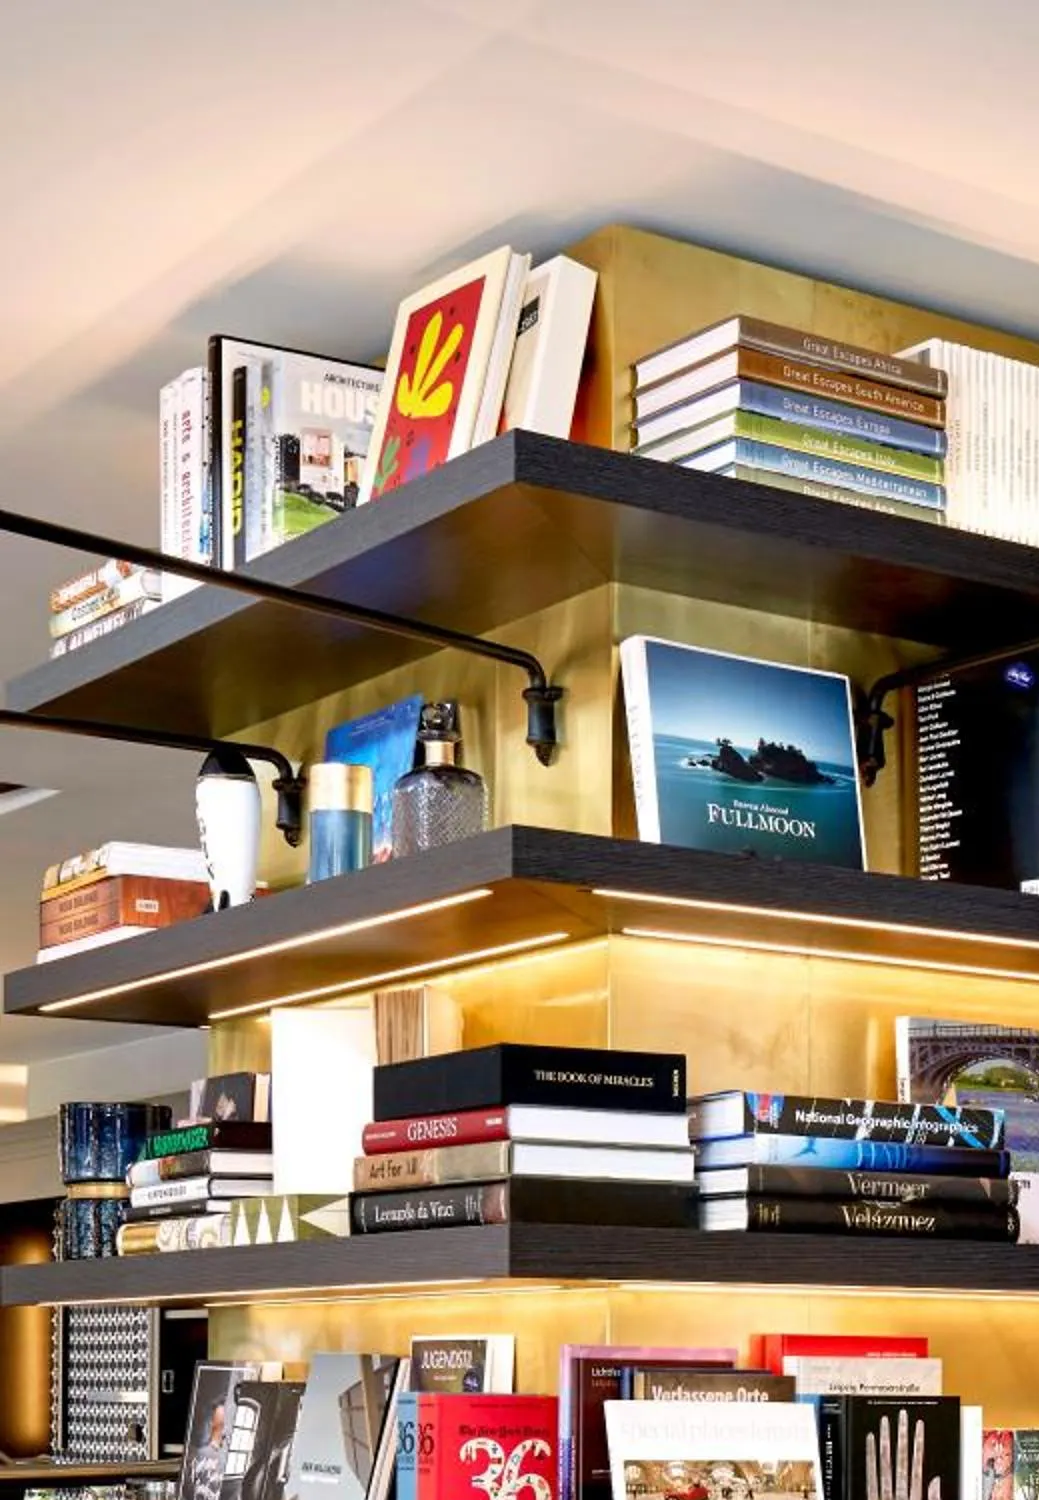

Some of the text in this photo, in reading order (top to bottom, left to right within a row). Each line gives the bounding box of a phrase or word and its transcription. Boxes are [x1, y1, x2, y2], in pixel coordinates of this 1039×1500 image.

[813, 372, 852, 393] Escapes
[706, 803, 817, 838] FULLMOON
[533, 1069, 655, 1088] THE BOOK OF MIRACLES
[407, 1117, 459, 1142] GENESIS
[795, 1109, 845, 1125] National
[846, 1114, 911, 1133] Geographic
[369, 1163, 385, 1179] Art
[387, 1159, 402, 1177] For
[847, 1172, 931, 1200] Vermeer
[374, 1199, 455, 1223] Leonardo da Vinci
[651, 1384, 770, 1403] Verlassene Orte
